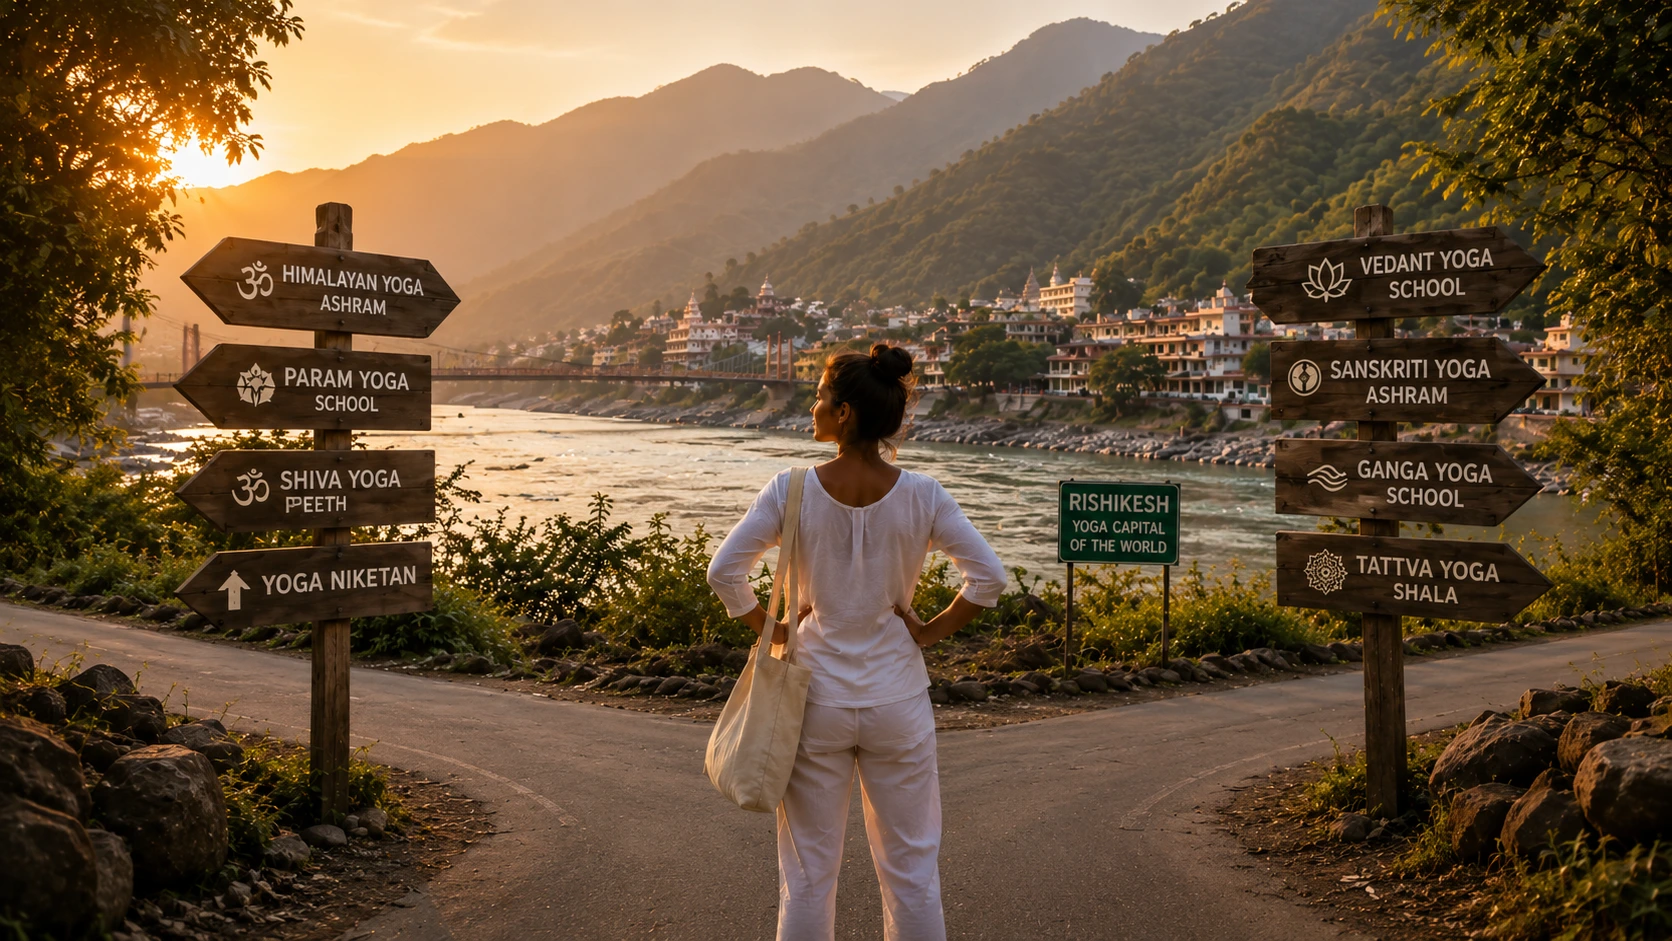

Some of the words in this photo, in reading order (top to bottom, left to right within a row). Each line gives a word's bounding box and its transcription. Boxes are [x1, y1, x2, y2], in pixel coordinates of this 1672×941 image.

[1360, 252, 1435, 275] VEDANT
[1439, 248, 1494, 270] YOGA
[282, 264, 377, 291] HIMALAYAN
[381, 275, 425, 297] YOGA
[1388, 277, 1467, 299] SCHOOL
[319, 294, 387, 316] ASHRAM
[284, 367, 353, 389] PARAM
[358, 370, 410, 391] YOGA
[1329, 359, 1428, 379] SANSKRITI
[1434, 359, 1491, 379] YOGA
[314, 394, 380, 412] SCHOOL
[1365, 386, 1448, 404] ASHRAM
[280, 470, 342, 490] SHIVA
[348, 469, 402, 489] YOGA
[1357, 460, 1429, 481] GANGA
[1434, 462, 1494, 484] YOGA
[1069, 493, 1169, 514] RISHIKESH
[1386, 487, 1465, 508] SCHOOL
[1072, 519, 1108, 534] YOGA
[1112, 520, 1166, 535] CAPITAL
[1070, 538, 1087, 552] OF
[1091, 539, 1116, 553] THE
[1120, 540, 1167, 554] WORLD
[261, 572, 324, 593] YOGA
[330, 565, 417, 590] NIKETAN
[1355, 556, 1434, 578] TATTVA
[1439, 560, 1500, 583] YOGA
[1392, 583, 1459, 604] SHALA
